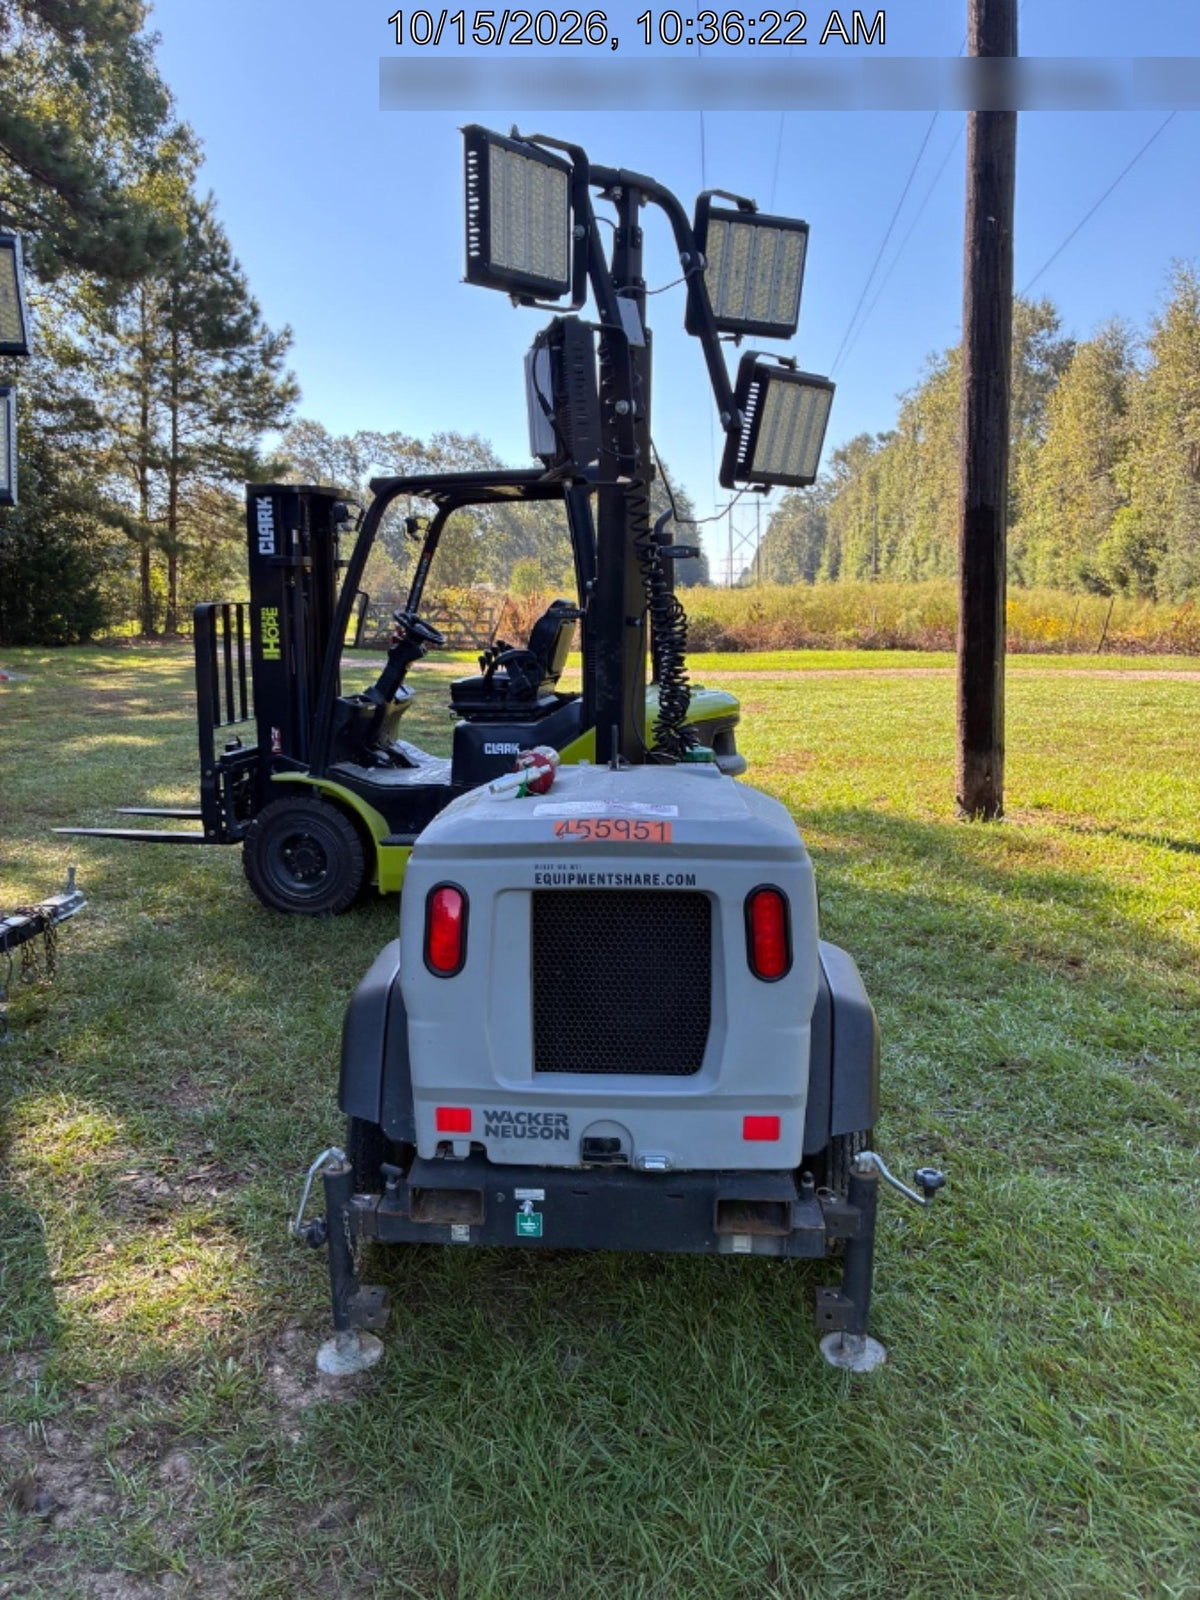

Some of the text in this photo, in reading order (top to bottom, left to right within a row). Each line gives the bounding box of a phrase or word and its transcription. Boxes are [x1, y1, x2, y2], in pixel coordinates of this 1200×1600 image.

[257, 496, 275, 555] CLARK
[484, 742, 520, 755] CLARK
[555, 819, 667, 842] 455951
[534, 872, 697, 887] EQUIPMENTSHARE.COM
[483, 1109, 569, 1126] WACKER
[484, 1125, 570, 1141] NEUSON
